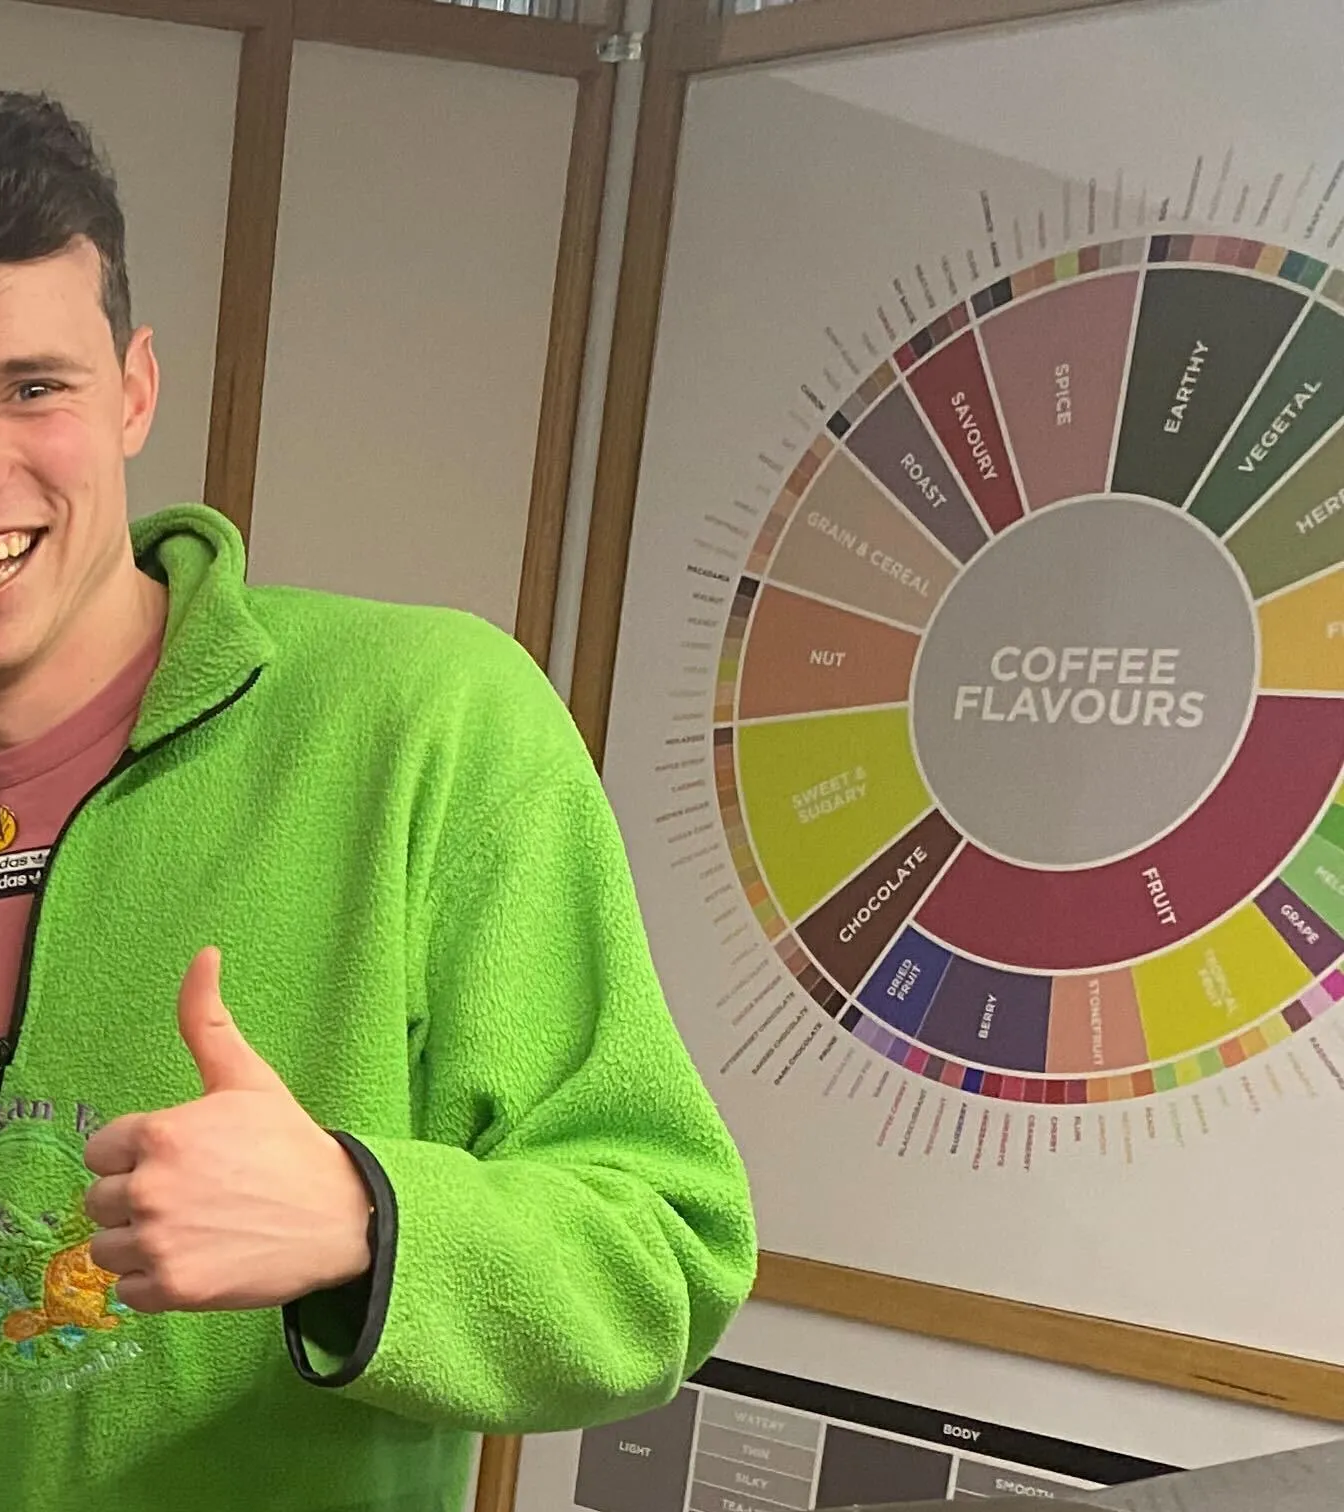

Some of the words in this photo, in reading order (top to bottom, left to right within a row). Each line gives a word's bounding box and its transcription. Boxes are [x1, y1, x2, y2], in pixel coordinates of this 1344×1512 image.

[1055, 362, 1071, 426] SPICE
[1163, 339, 1210, 434] EARTHY
[951, 391, 998, 481] SAVOURY
[1237, 378, 1324, 474] VEGETAL
[900, 453, 948, 508] ROAST
[685, 564, 731, 583] MACADAMIA
[807, 512, 857, 550] GRAIN
[870, 549, 930, 597] CEREAL
[808, 649, 846, 668] NUT
[989, 644, 1180, 686] COFFEE
[953, 684, 1206, 728] FLAVOURS
[791, 770, 848, 812] SWEET
[796, 783, 868, 825] SUGARY
[838, 845, 928, 944] CHOCOLATE
[1141, 867, 1177, 927] FRUIT
[1280, 903, 1321, 946] GRAPE
[886, 958, 914, 999] DRIED
[896, 966, 923, 1001] FRUIT
[756, 991, 796, 1032] CHOCOLATE
[771, 1006, 809, 1048] CHOCOLATE
[977, 994, 998, 1040] BERRY
[1087, 979, 1105, 1068] STONEFRUIT
[786, 1021, 824, 1065] CHOCOLATE
[894, 1088, 929, 1156] BLACKCURRANT
[947, 1102, 969, 1153] BLUEBERRY
[970, 1108, 991, 1170] STRAWBERRY
[734, 1410, 786, 1432] WATERY
[943, 1423, 981, 1442] BODY
[618, 1441, 652, 1458] LIGHT
[741, 1444, 771, 1460] THIN
[734, 1472, 770, 1490] SILKY
